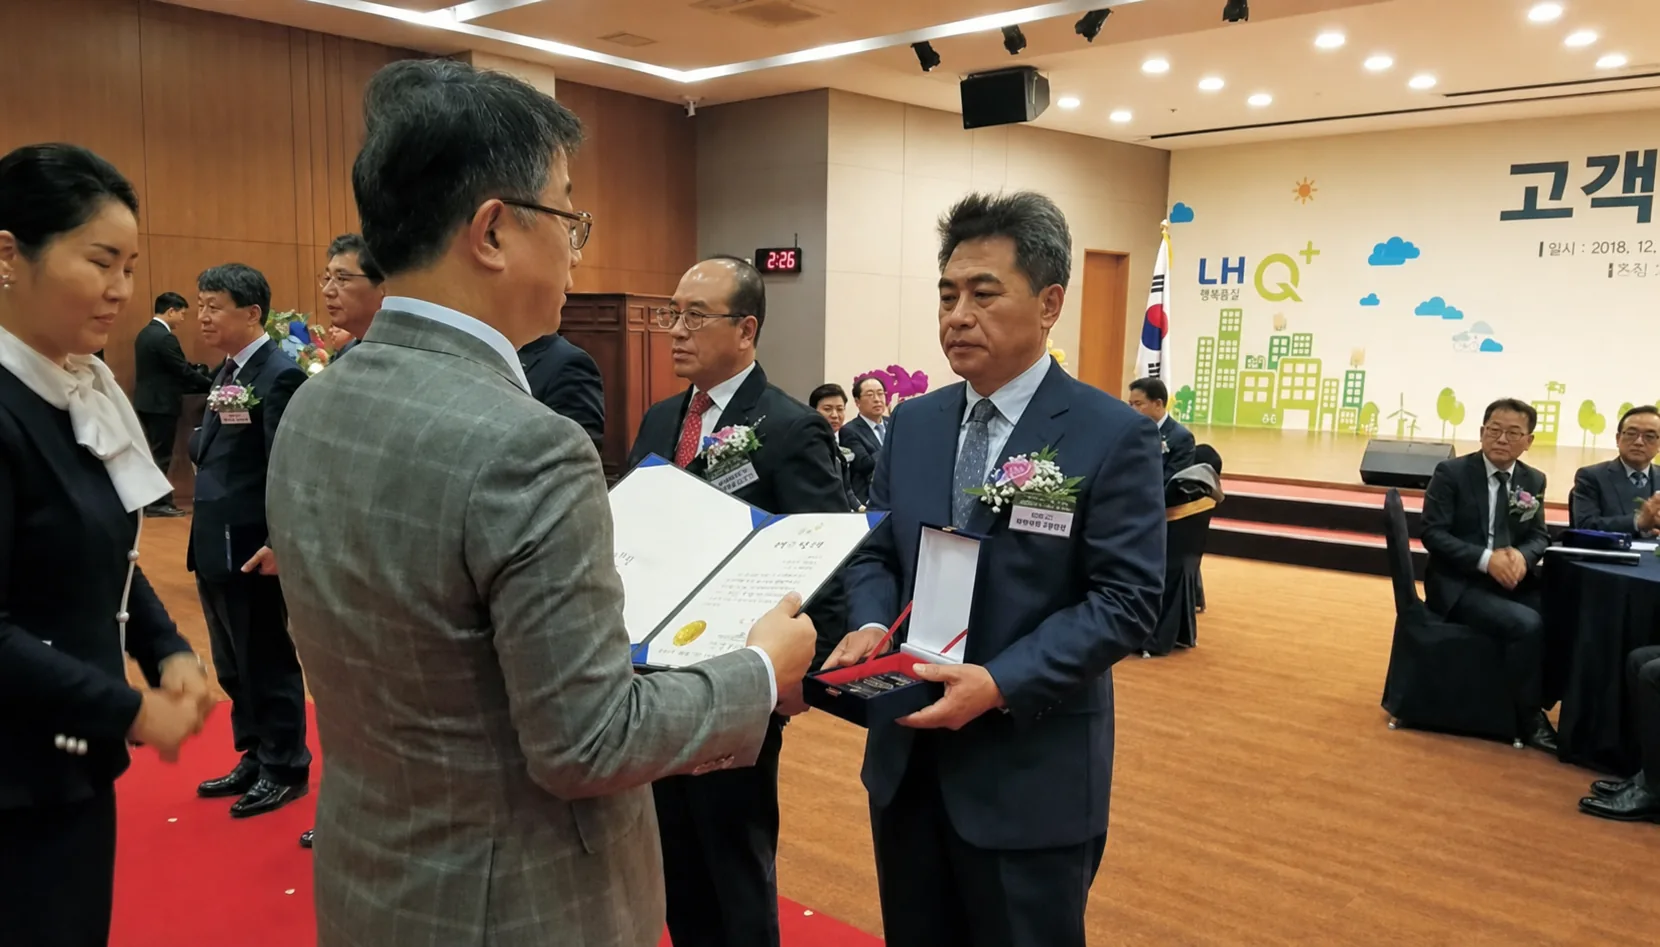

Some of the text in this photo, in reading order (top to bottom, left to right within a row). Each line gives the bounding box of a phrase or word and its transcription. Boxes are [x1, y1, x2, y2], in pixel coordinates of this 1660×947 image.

[1500, 149, 1658, 224] 고객
[767, 251, 795, 268] 2:26
[1548, 241, 1576, 257] 일시
[1591, 240, 1630, 254] 2018.
[1638, 239, 1657, 253] 12.
[1198, 256, 1246, 284] LH
